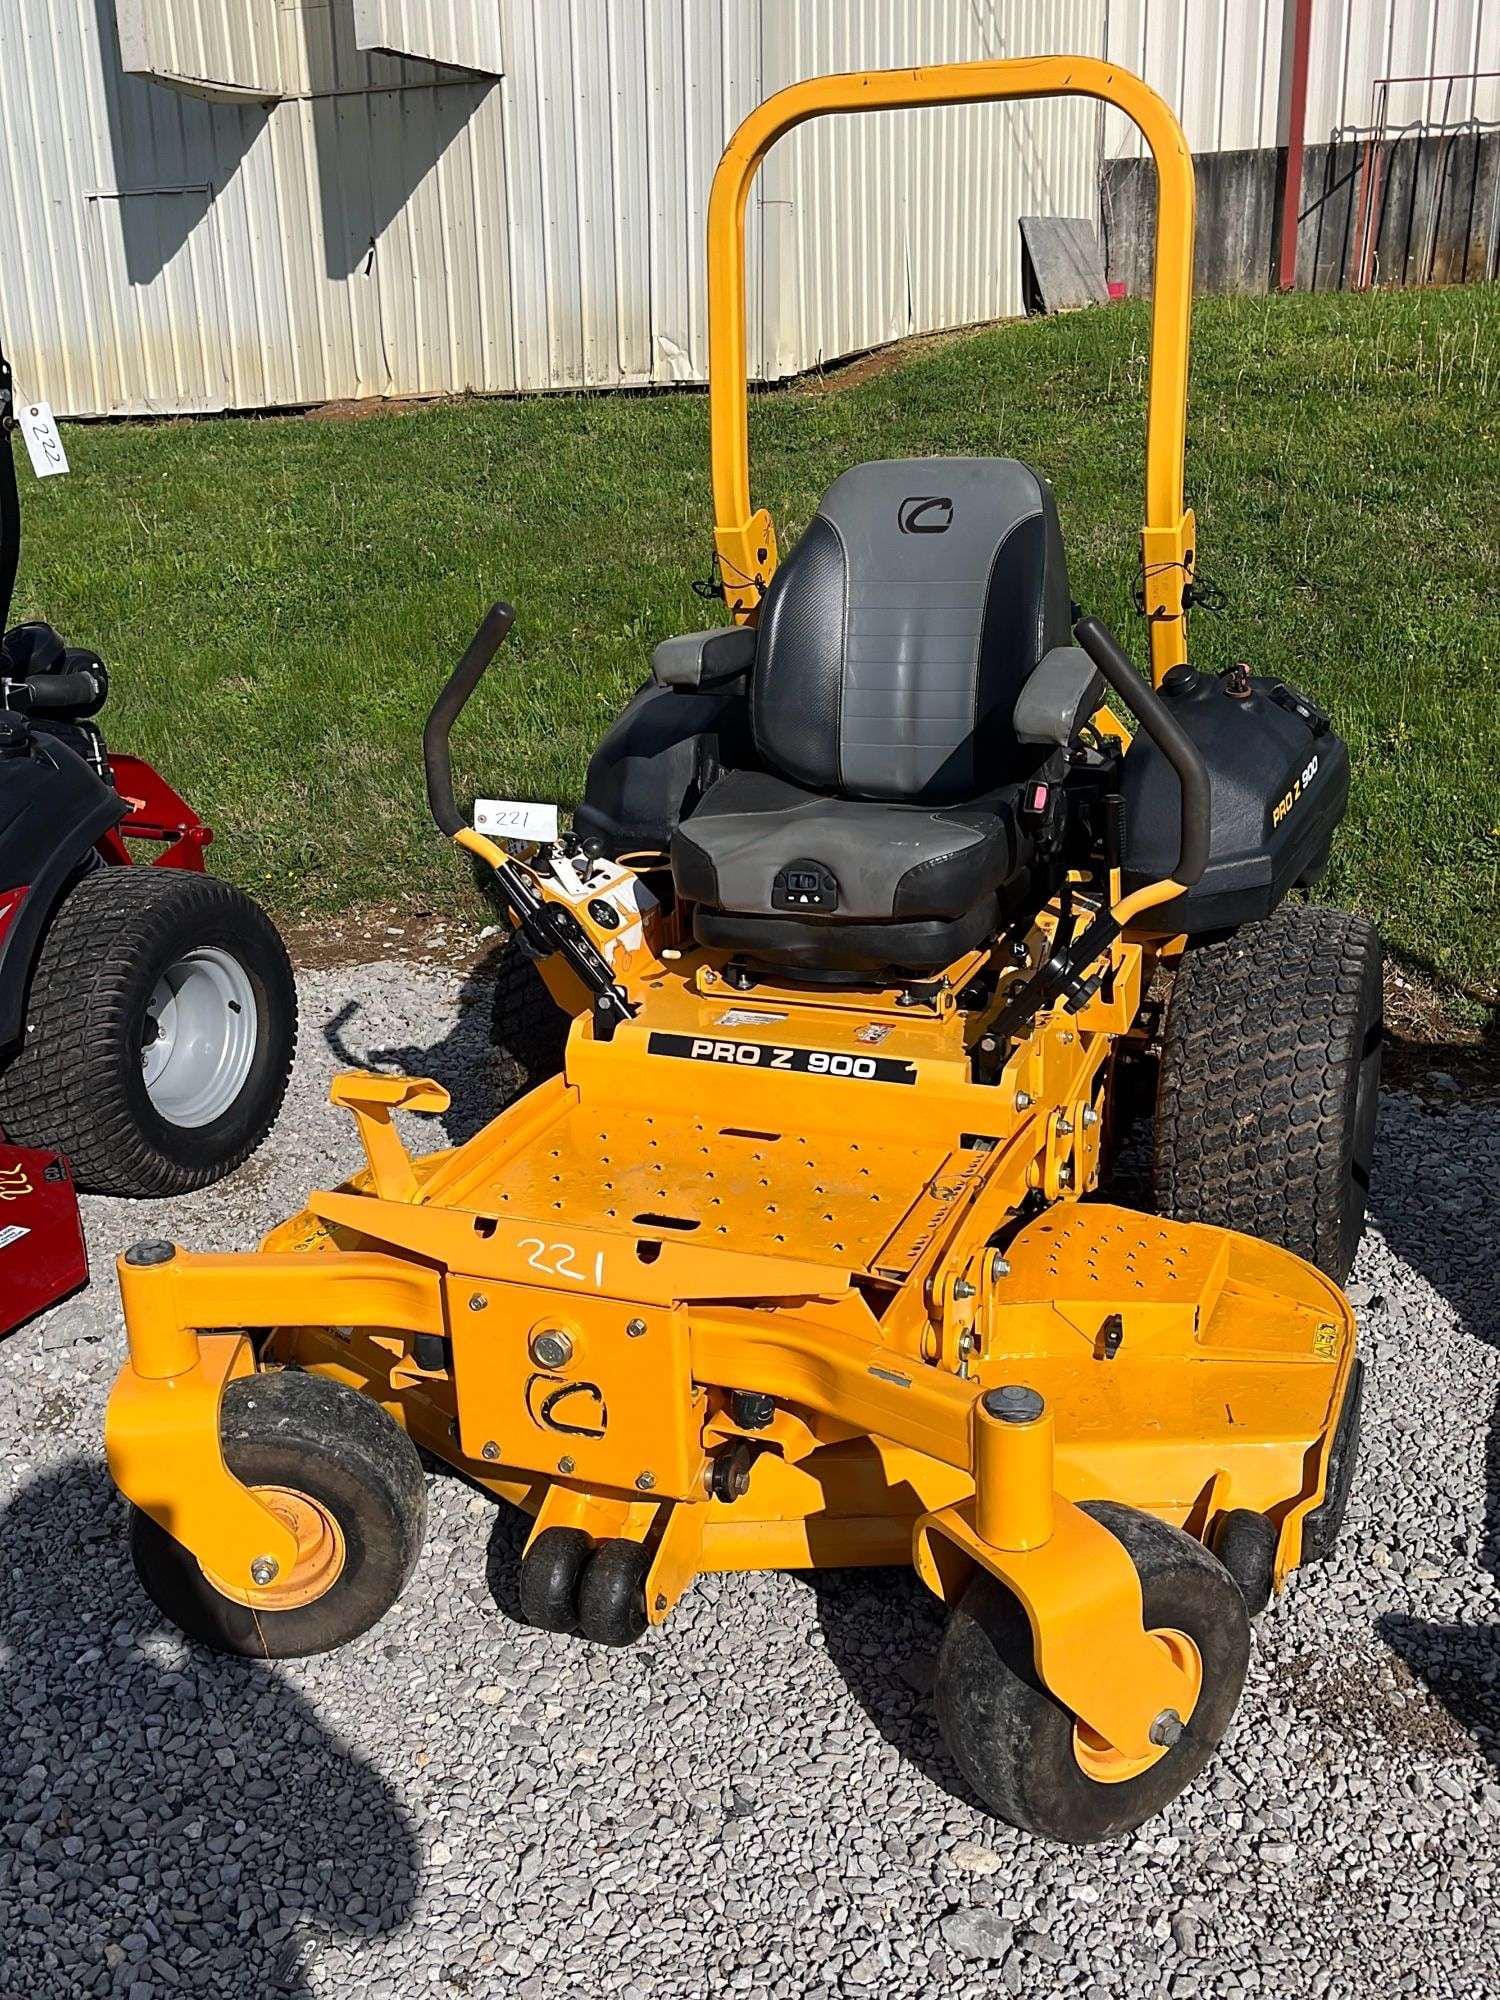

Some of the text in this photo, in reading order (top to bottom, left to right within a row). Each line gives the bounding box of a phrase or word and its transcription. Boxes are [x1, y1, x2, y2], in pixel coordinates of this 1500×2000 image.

[33, 424, 60, 469] 222
[1273, 755, 1318, 828] PRO Z 900
[495, 811, 529, 829] 221
[691, 1040, 877, 1079] PRO Z 900
[517, 1238, 604, 1288] 221
